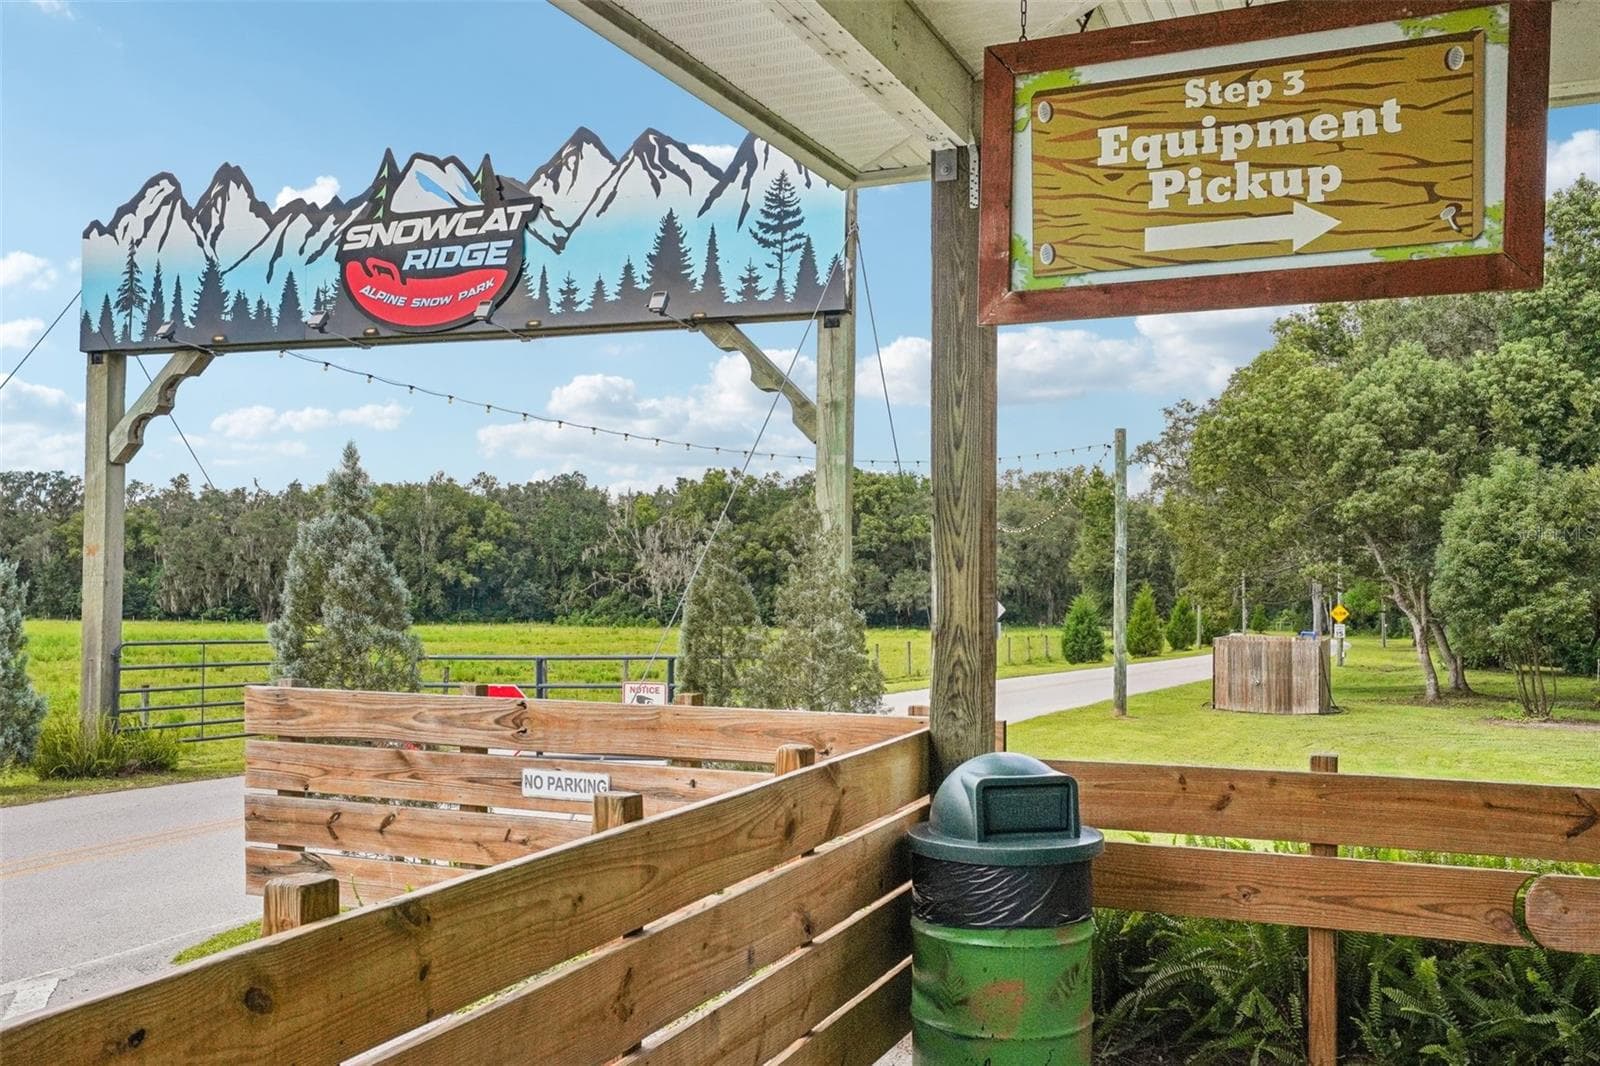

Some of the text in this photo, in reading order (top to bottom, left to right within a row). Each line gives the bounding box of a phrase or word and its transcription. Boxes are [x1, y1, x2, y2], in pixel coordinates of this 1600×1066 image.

[1184, 69, 1305, 108] Step 3
[1097, 98, 1403, 169] Equipment
[1148, 161, 1343, 209] Pickup
[342, 203, 535, 251] SNOWCAT
[402, 239, 514, 271] RIDGE
[358, 277, 496, 308] ALPINE SNOW PARK
[629, 685, 661, 695] NOTICE
[524, 774, 607, 794] NO PARKING
